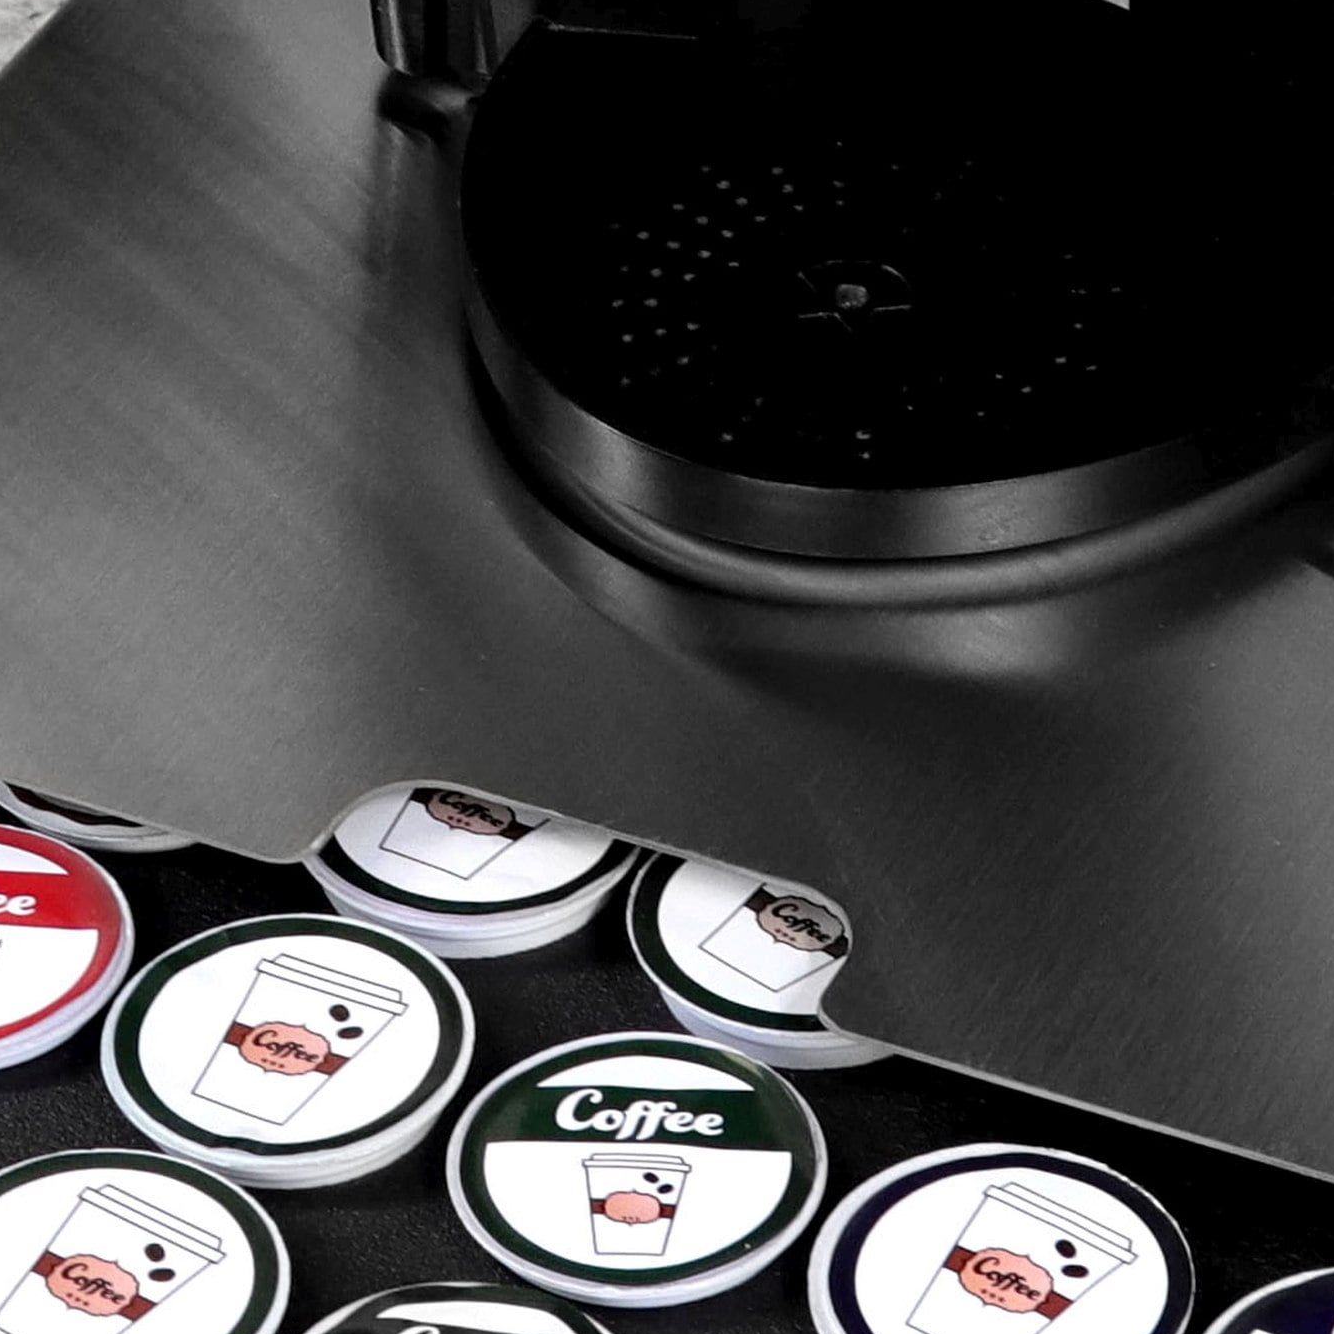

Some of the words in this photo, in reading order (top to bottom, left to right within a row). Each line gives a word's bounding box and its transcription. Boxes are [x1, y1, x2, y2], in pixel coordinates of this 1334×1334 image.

[439, 791, 504, 827] Coffee
[772, 903, 831, 942] Coffee
[252, 1029, 319, 1063] Coffee
[555, 1088, 723, 1141] Coffee
[61, 1262, 125, 1304] Coffee
[972, 1256, 1041, 1300] Coffee
